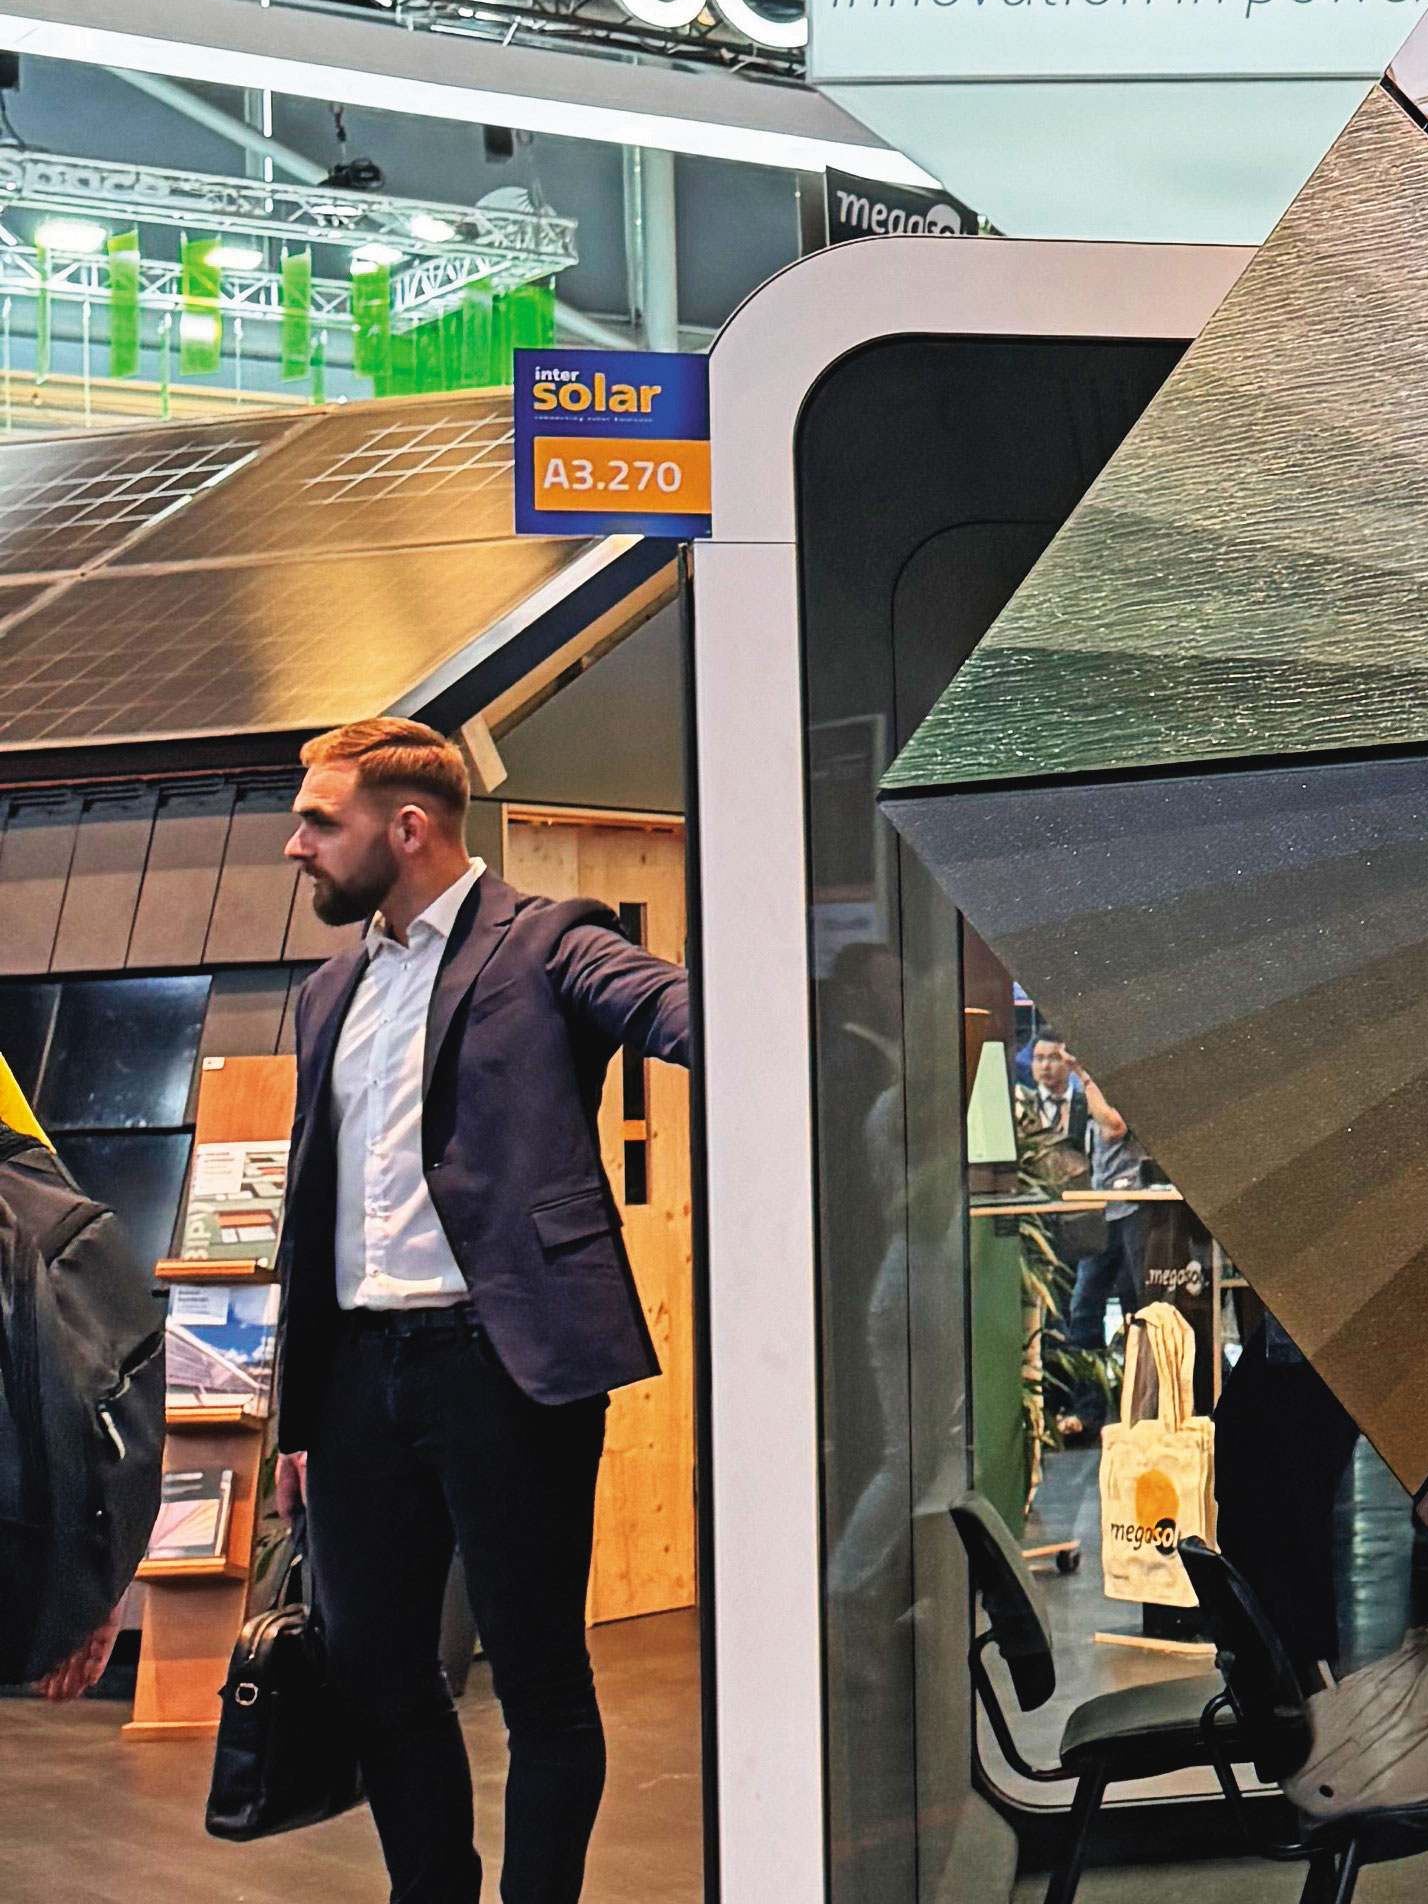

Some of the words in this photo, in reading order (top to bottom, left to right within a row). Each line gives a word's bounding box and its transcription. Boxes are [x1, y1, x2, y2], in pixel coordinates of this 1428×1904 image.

[535, 366, 580, 382] inter
[532, 372, 662, 413] solar
[543, 458, 682, 493] A3.270
